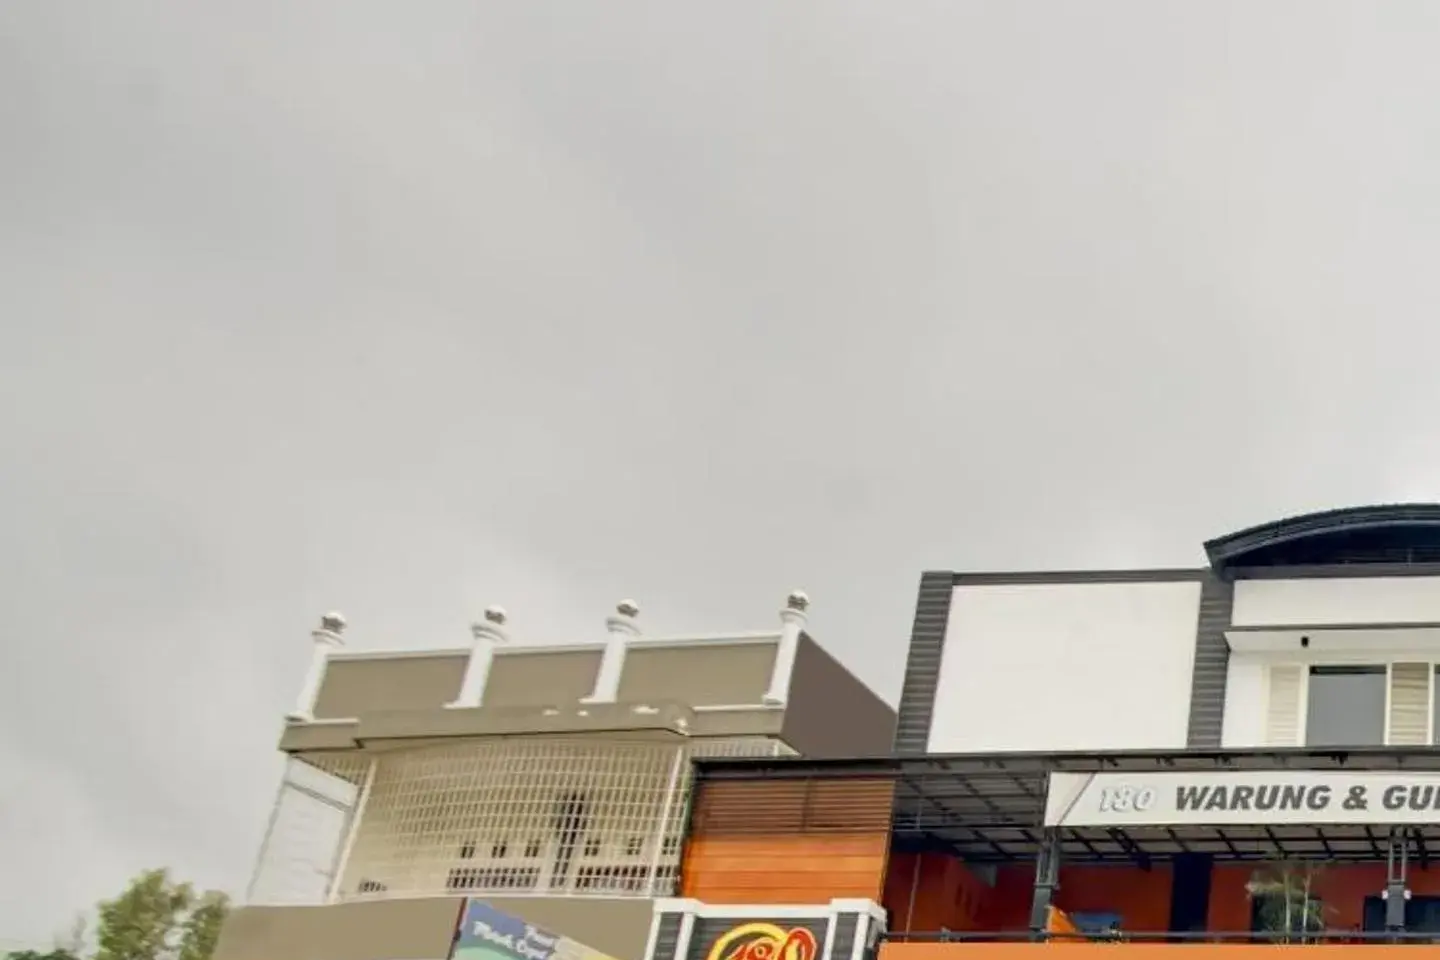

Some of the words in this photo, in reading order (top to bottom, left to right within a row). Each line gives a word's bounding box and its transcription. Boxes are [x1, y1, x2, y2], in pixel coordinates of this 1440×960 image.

[1099, 787, 1154, 813] 180
[1176, 785, 1331, 811] WARUNG
[1342, 786, 1368, 810] &
